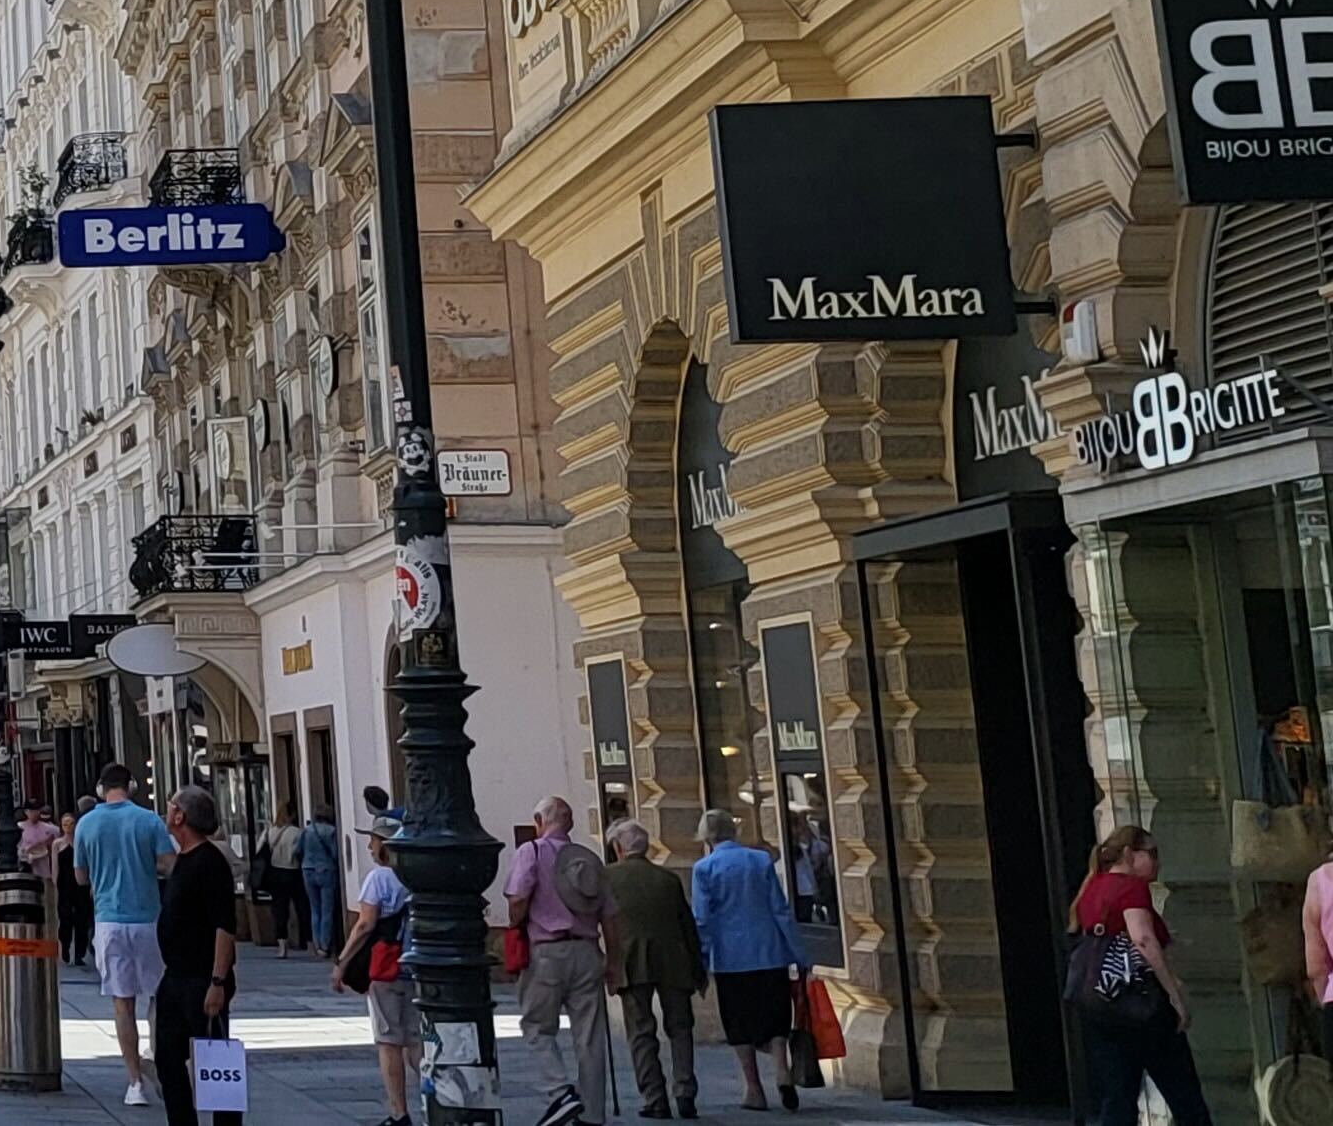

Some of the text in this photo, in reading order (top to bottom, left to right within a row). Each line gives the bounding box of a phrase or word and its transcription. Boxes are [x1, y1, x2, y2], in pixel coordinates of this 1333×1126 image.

[1205, 137, 1333, 162] BIJOU BRIG
[83, 213, 245, 254] Berlitz
[767, 274, 985, 321] MaxMara
[1073, 409, 1133, 474] BIJOU
[20, 627, 58, 644] IWC
[199, 1068, 242, 1082] BOSS
